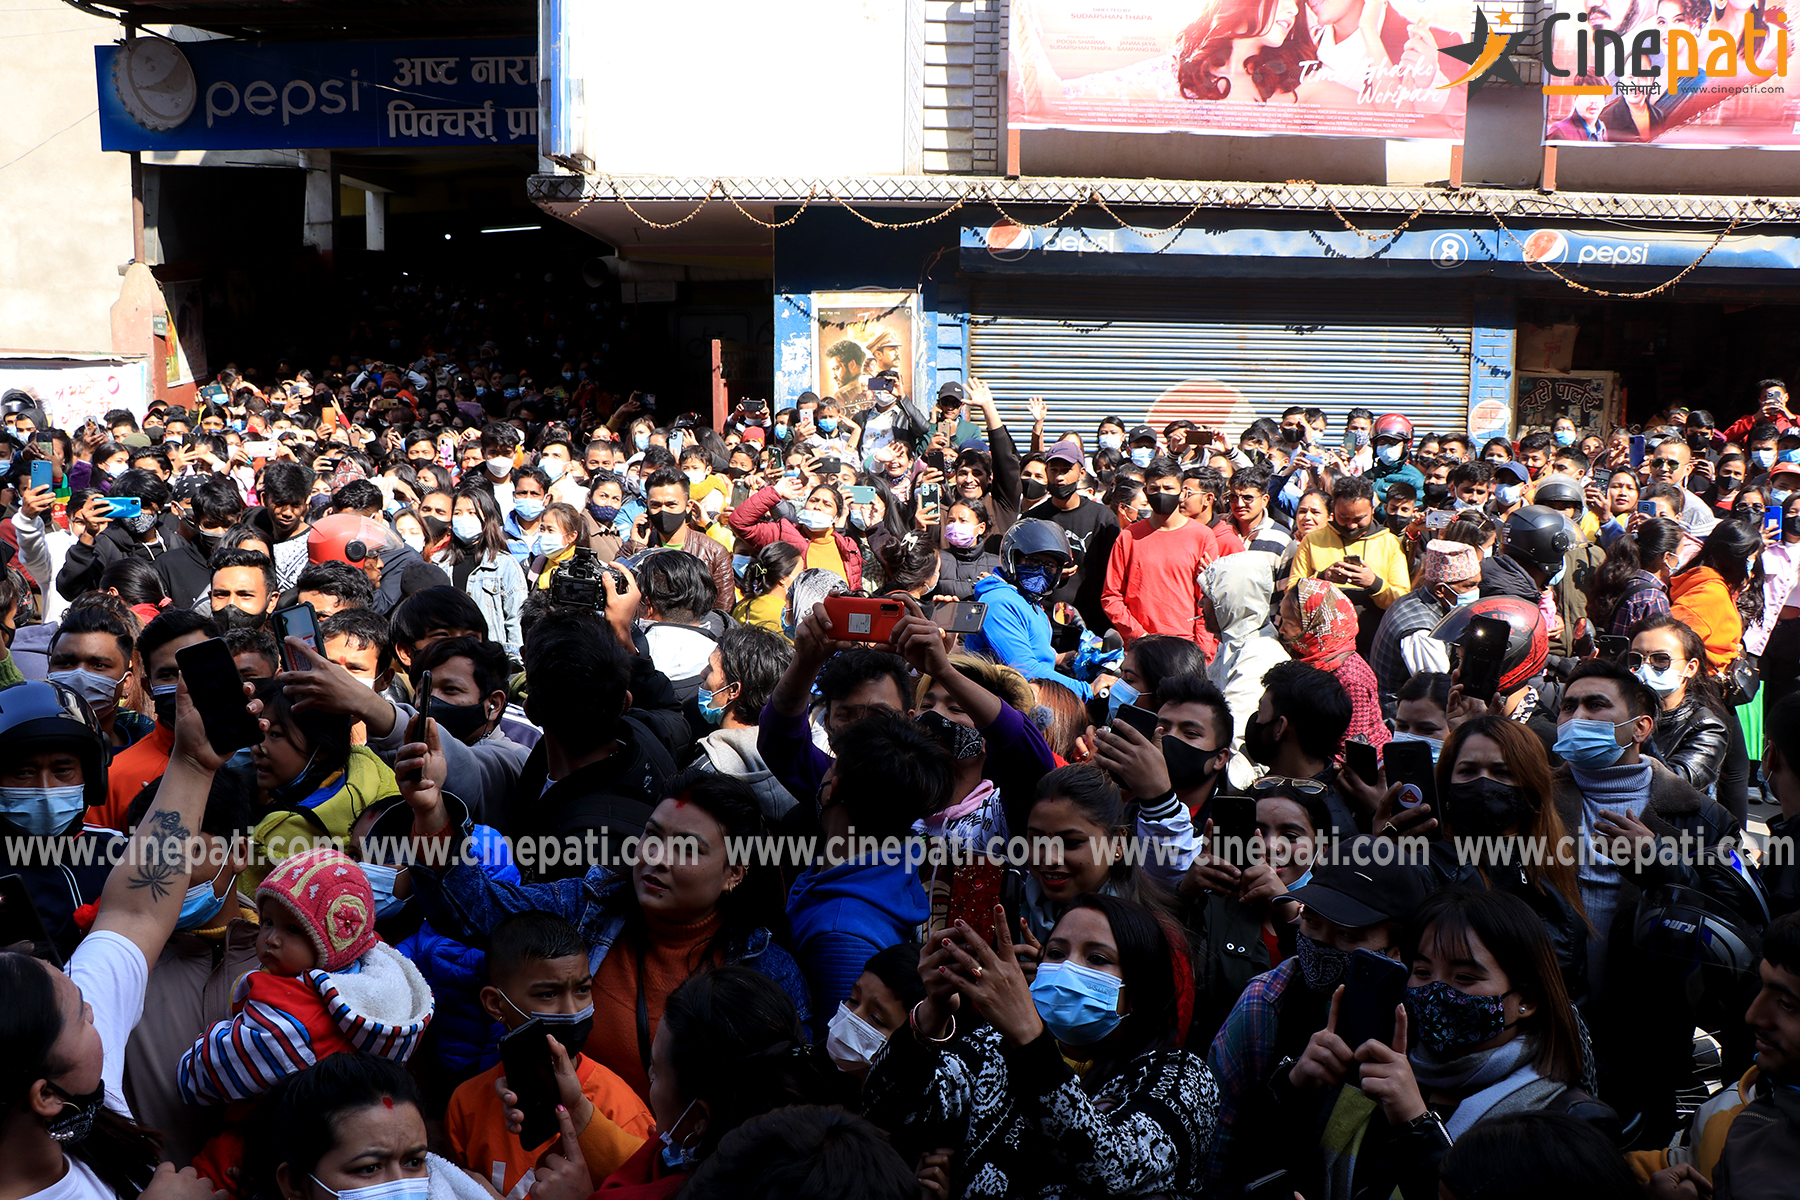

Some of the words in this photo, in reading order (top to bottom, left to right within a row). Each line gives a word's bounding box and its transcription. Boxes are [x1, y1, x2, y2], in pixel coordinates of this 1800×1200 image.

[392, 55, 459, 88] अष्ट
[205, 69, 361, 129] pepsi
[1042, 231, 1116, 258] pepsi
[1578, 242, 1650, 269] pepsi
